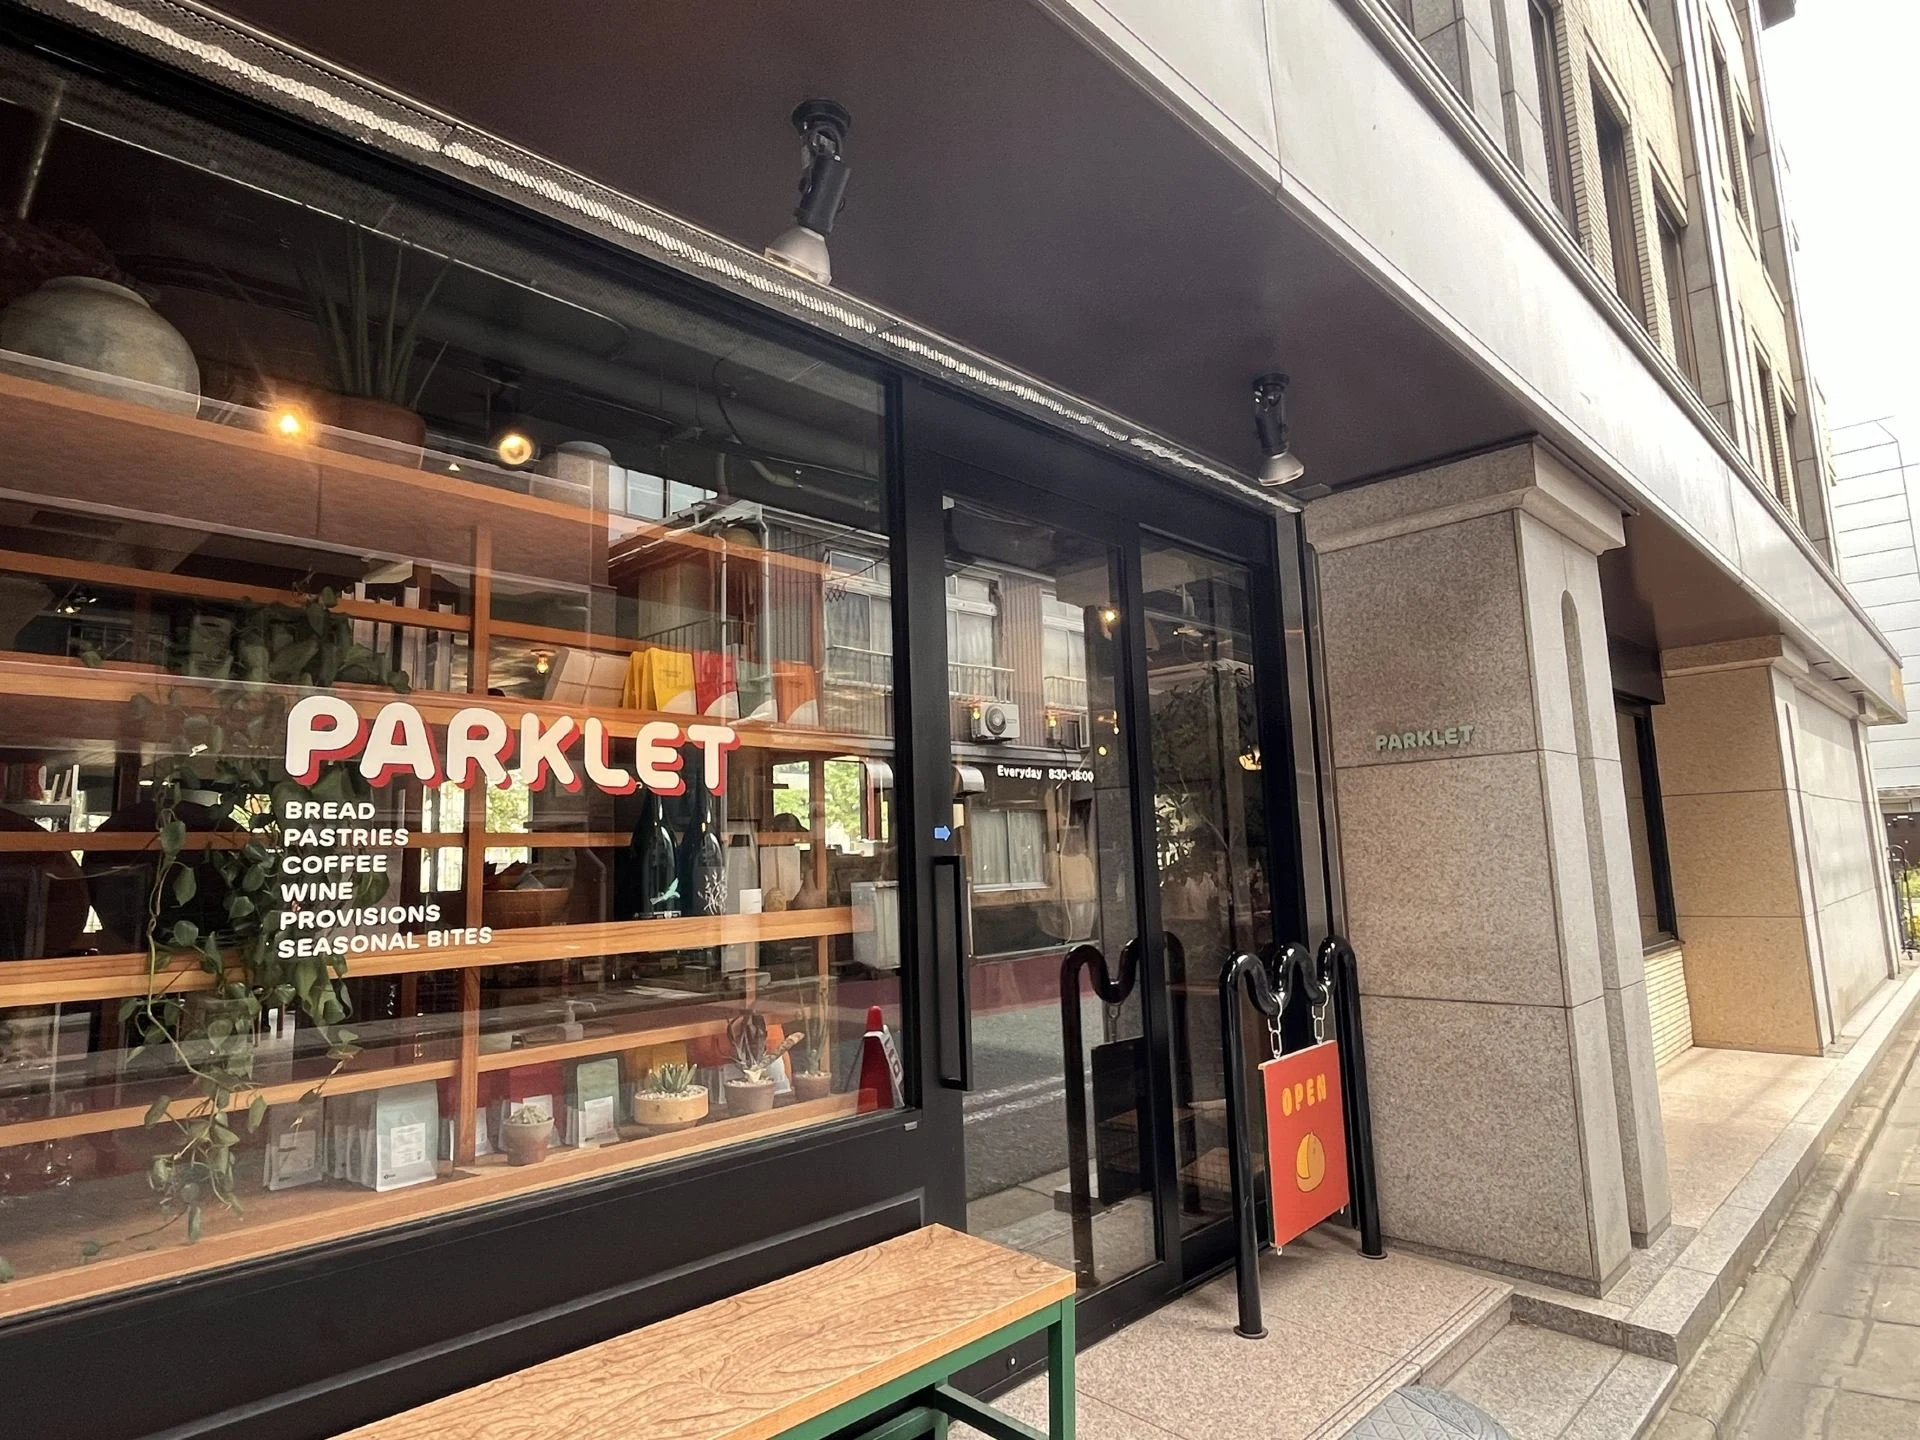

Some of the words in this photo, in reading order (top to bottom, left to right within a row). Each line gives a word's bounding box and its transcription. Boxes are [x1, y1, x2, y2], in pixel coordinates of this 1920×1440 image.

[285, 695, 740, 796] PARKLET
[1375, 724, 1475, 750] PARKLET
[997, 764, 1043, 780] Everyday
[1048, 768, 1095, 783] 8:30-18:00
[284, 801, 376, 820] BREAD
[283, 827, 410, 847] PASTRIES
[281, 854, 388, 875] COFFEE
[280, 881, 354, 902] WINE
[279, 904, 442, 931] PROVISIONS
[277, 932, 420, 960] SEASONAL
[427, 926, 494, 947] BITES
[1281, 1073, 1328, 1117] OPEN
